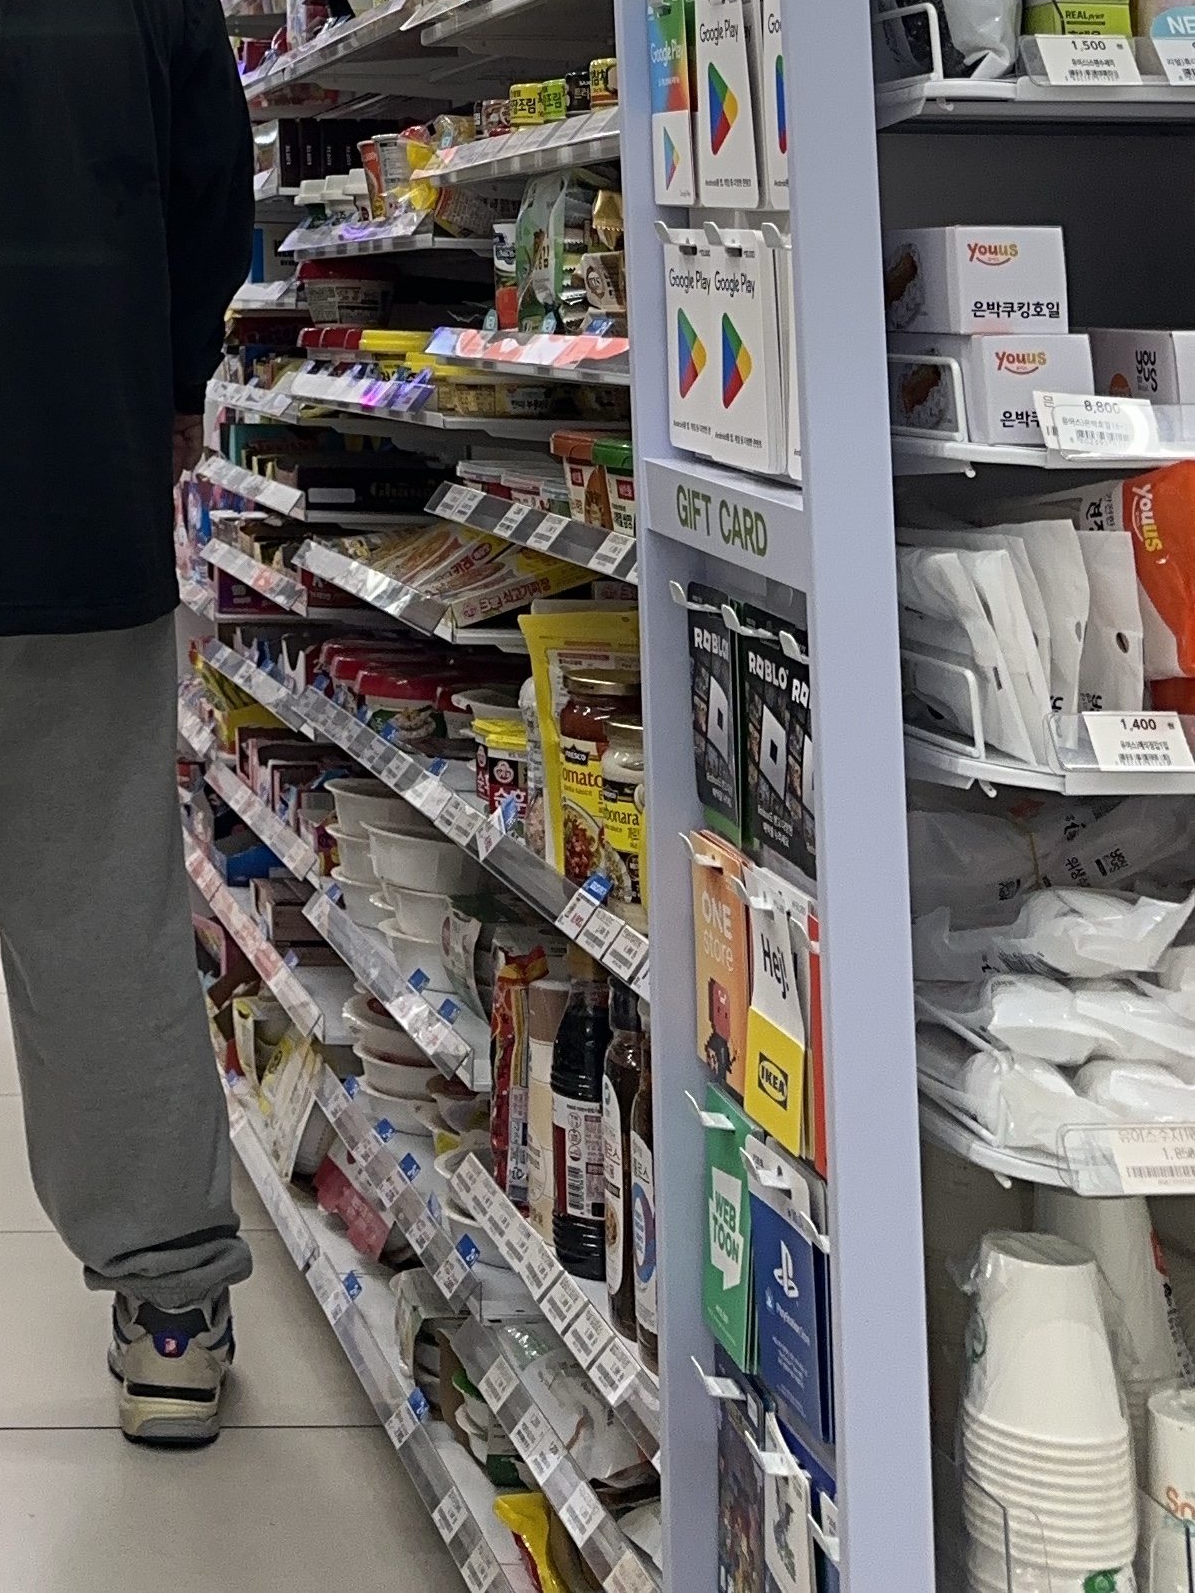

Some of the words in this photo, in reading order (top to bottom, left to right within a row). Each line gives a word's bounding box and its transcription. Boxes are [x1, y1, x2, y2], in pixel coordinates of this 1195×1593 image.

[699, 21, 724, 47] Google
[724, 18, 739, 43] Play
[1166, 16, 1195, 34] NE
[650, 42, 671, 67] Google
[1071, 40, 1106, 52] 1,500
[967, 242, 1019, 262] youus
[668, 268, 694, 295] Google
[695, 270, 711, 296] Play
[714, 271, 739, 299] Google
[740, 273, 756, 299] Play
[971, 300, 1061, 319] 은박쿠킹호일
[995, 351, 1048, 371] youus
[1000, 410, 1040, 428] 은박쿠
[1083, 399, 1121, 414] 8,800
[676, 484, 713, 537] GIFT
[718, 499, 768, 558] CARD
[1132, 483, 1163, 552] youus
[748, 651, 788, 691] ROBLO
[1120, 718, 1157, 731] 1,400
[562, 766, 604, 788] omato
[606, 810, 640, 826] bonara
[701, 890, 734, 941] ONE
[701, 929, 734, 973] store
[760, 932, 790, 1000] Hej!
[761, 1065, 787, 1096] IKEA
[715, 1190, 737, 1233] WEB
[712, 1214, 740, 1265] TOON
